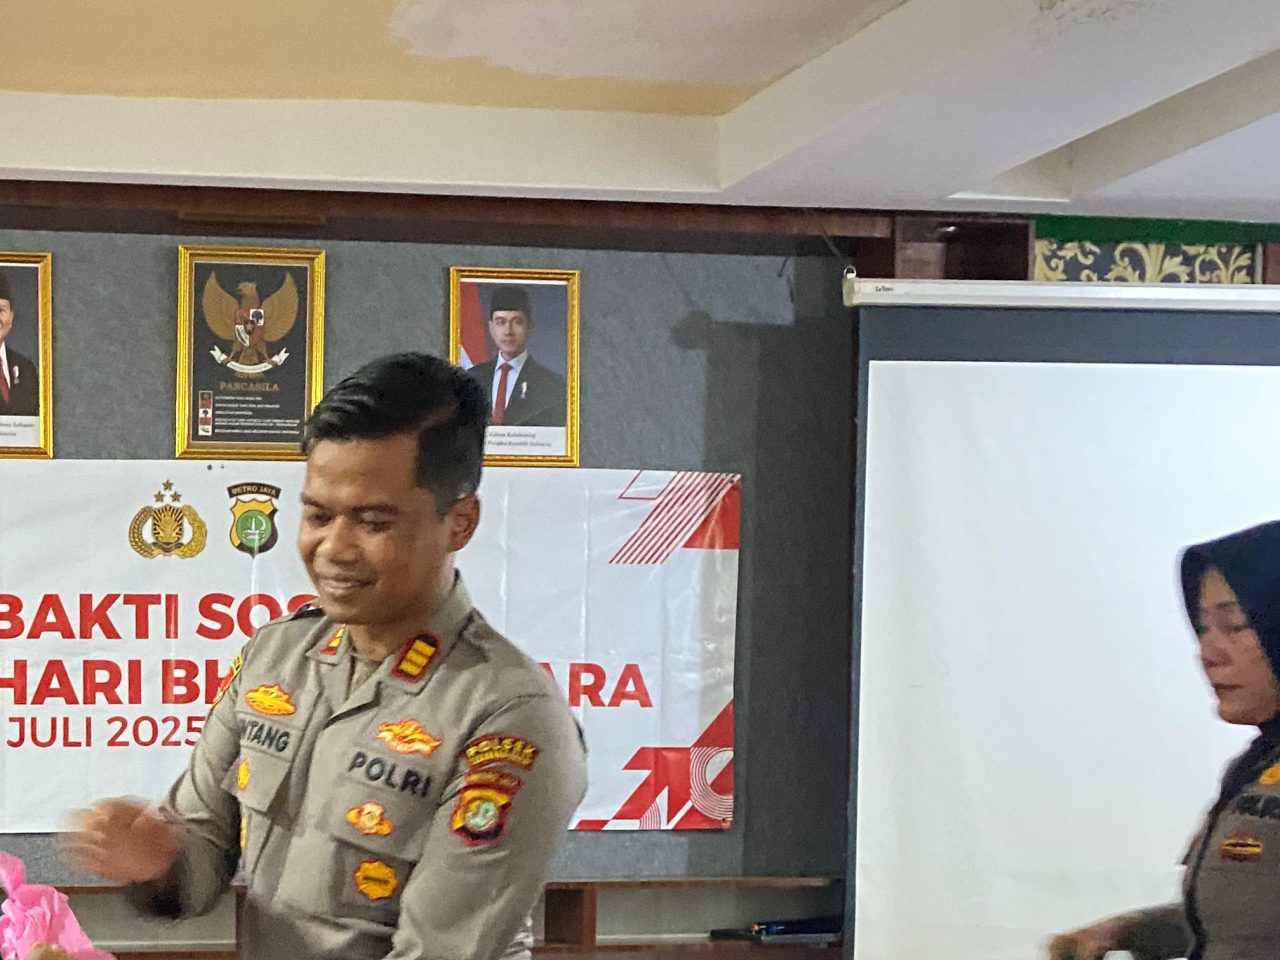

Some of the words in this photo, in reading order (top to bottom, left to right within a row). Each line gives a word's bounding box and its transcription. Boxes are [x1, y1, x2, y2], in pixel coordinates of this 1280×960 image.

[6, 716, 92, 748] JULI
[106, 715, 207, 747] 2025
[347, 751, 431, 798] POLRI
